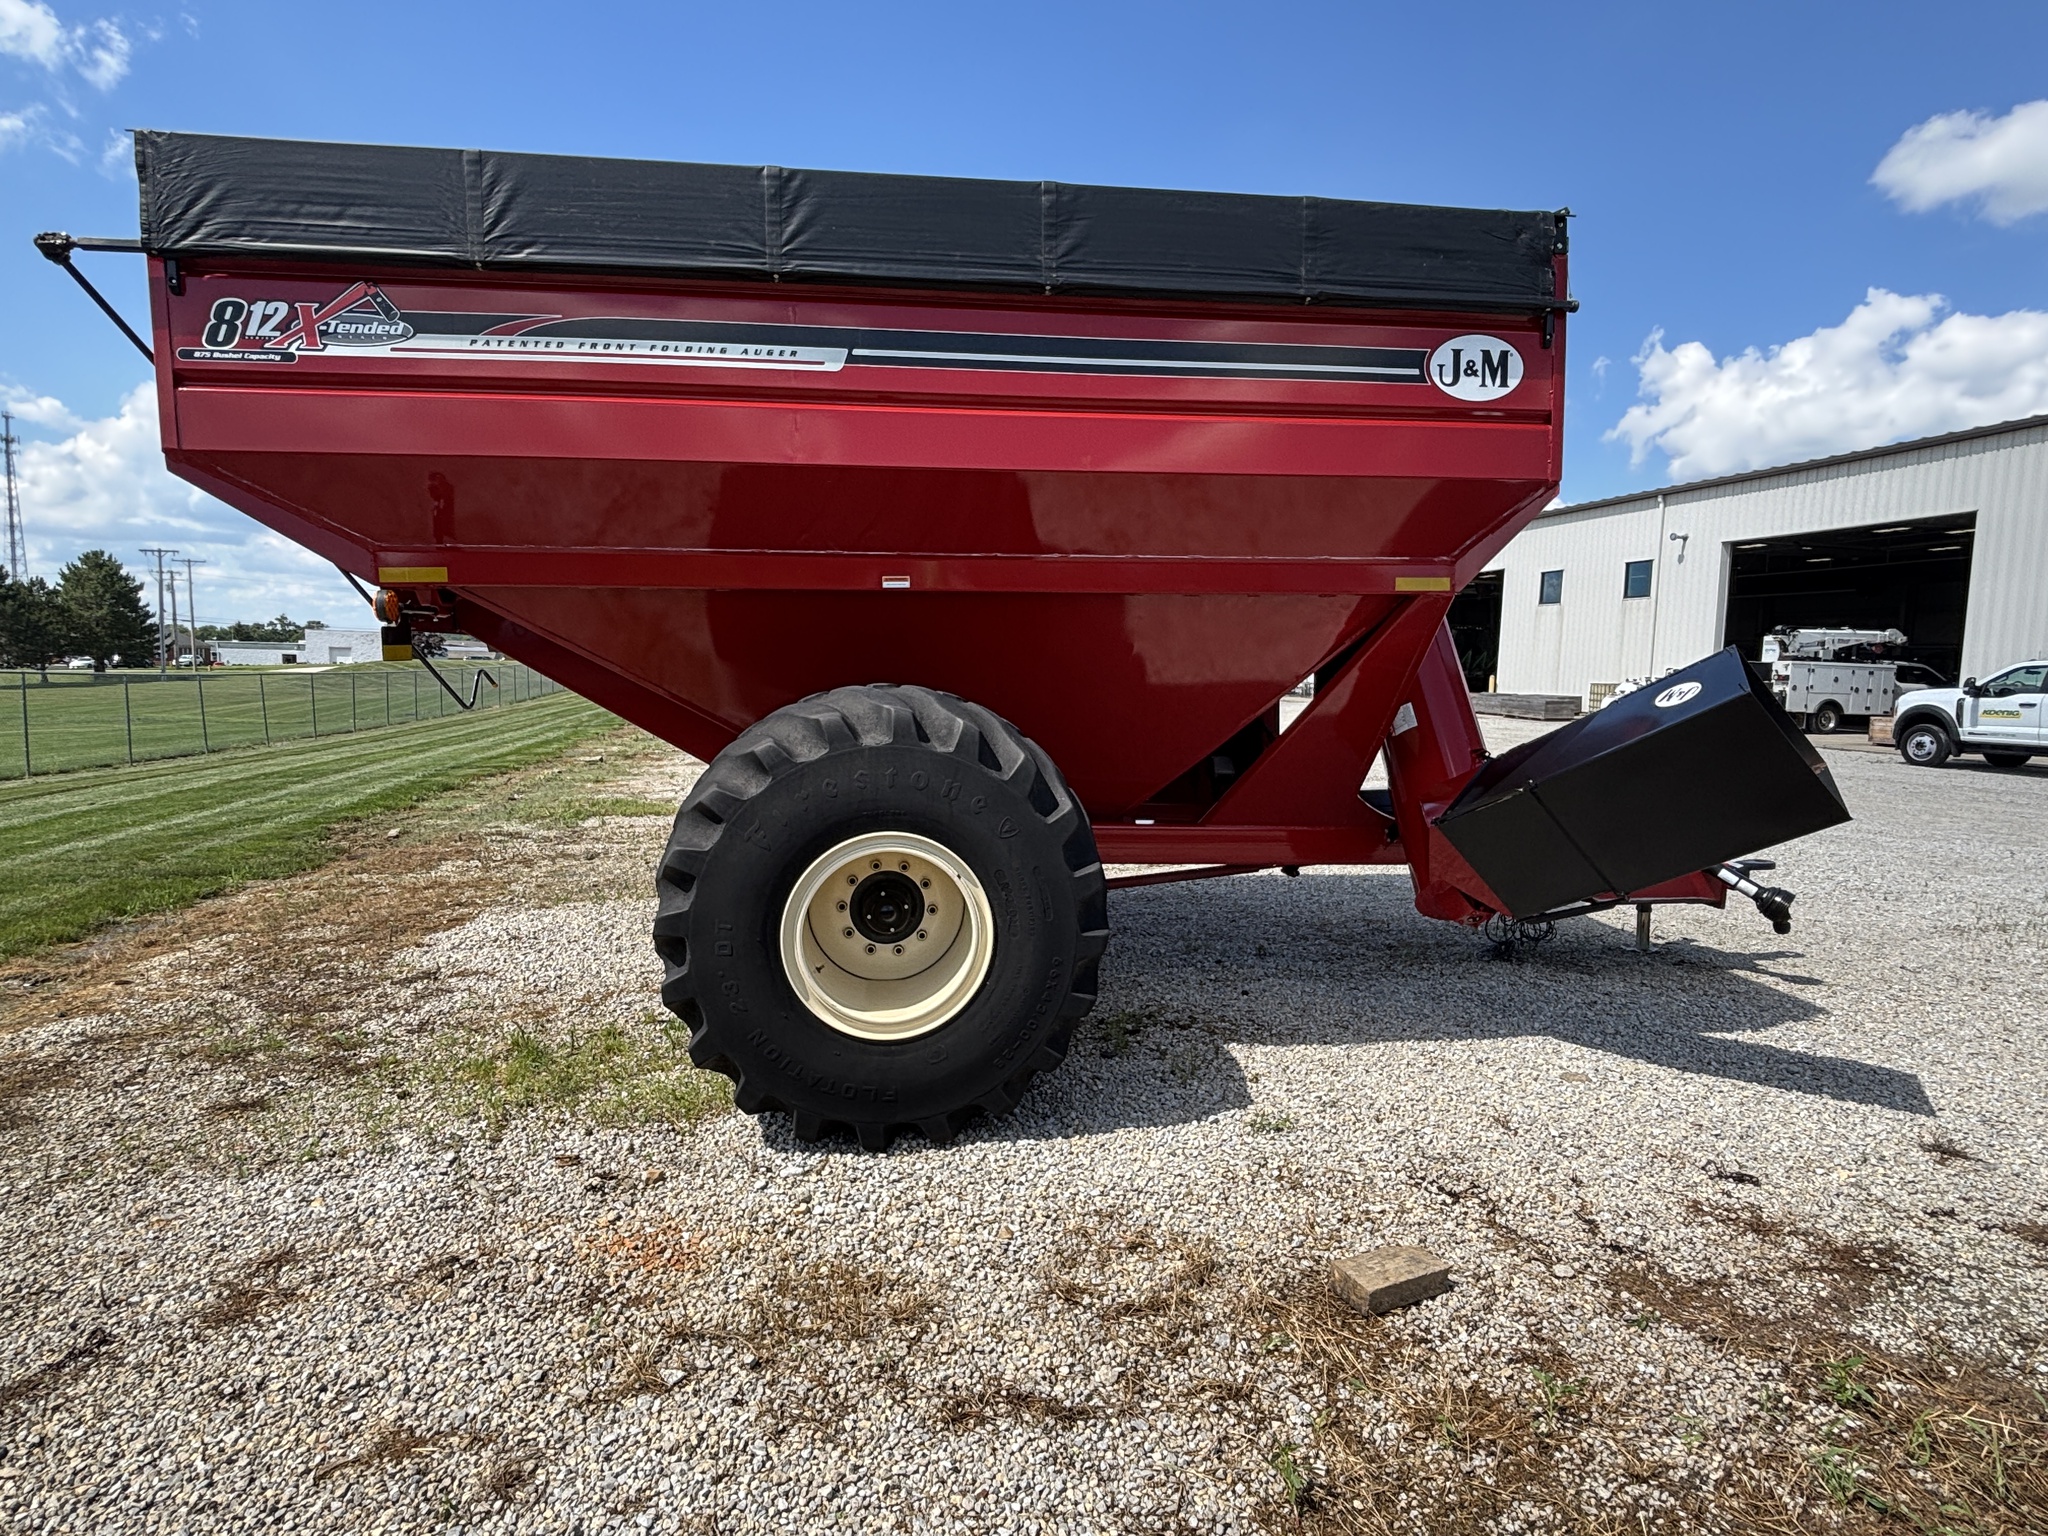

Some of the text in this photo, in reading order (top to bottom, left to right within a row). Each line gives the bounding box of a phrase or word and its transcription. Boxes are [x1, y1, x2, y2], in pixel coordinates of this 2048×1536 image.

[202, 298, 289, 349] 812
[244, 353, 281, 361] Capacity
[469, 339, 798, 357] PATENTED FRONT FOLDING AUGER
[1437, 348, 1511, 388] J&M
[744, 765, 987, 853] Firestone
[748, 1028, 898, 1104] FLOTATION
